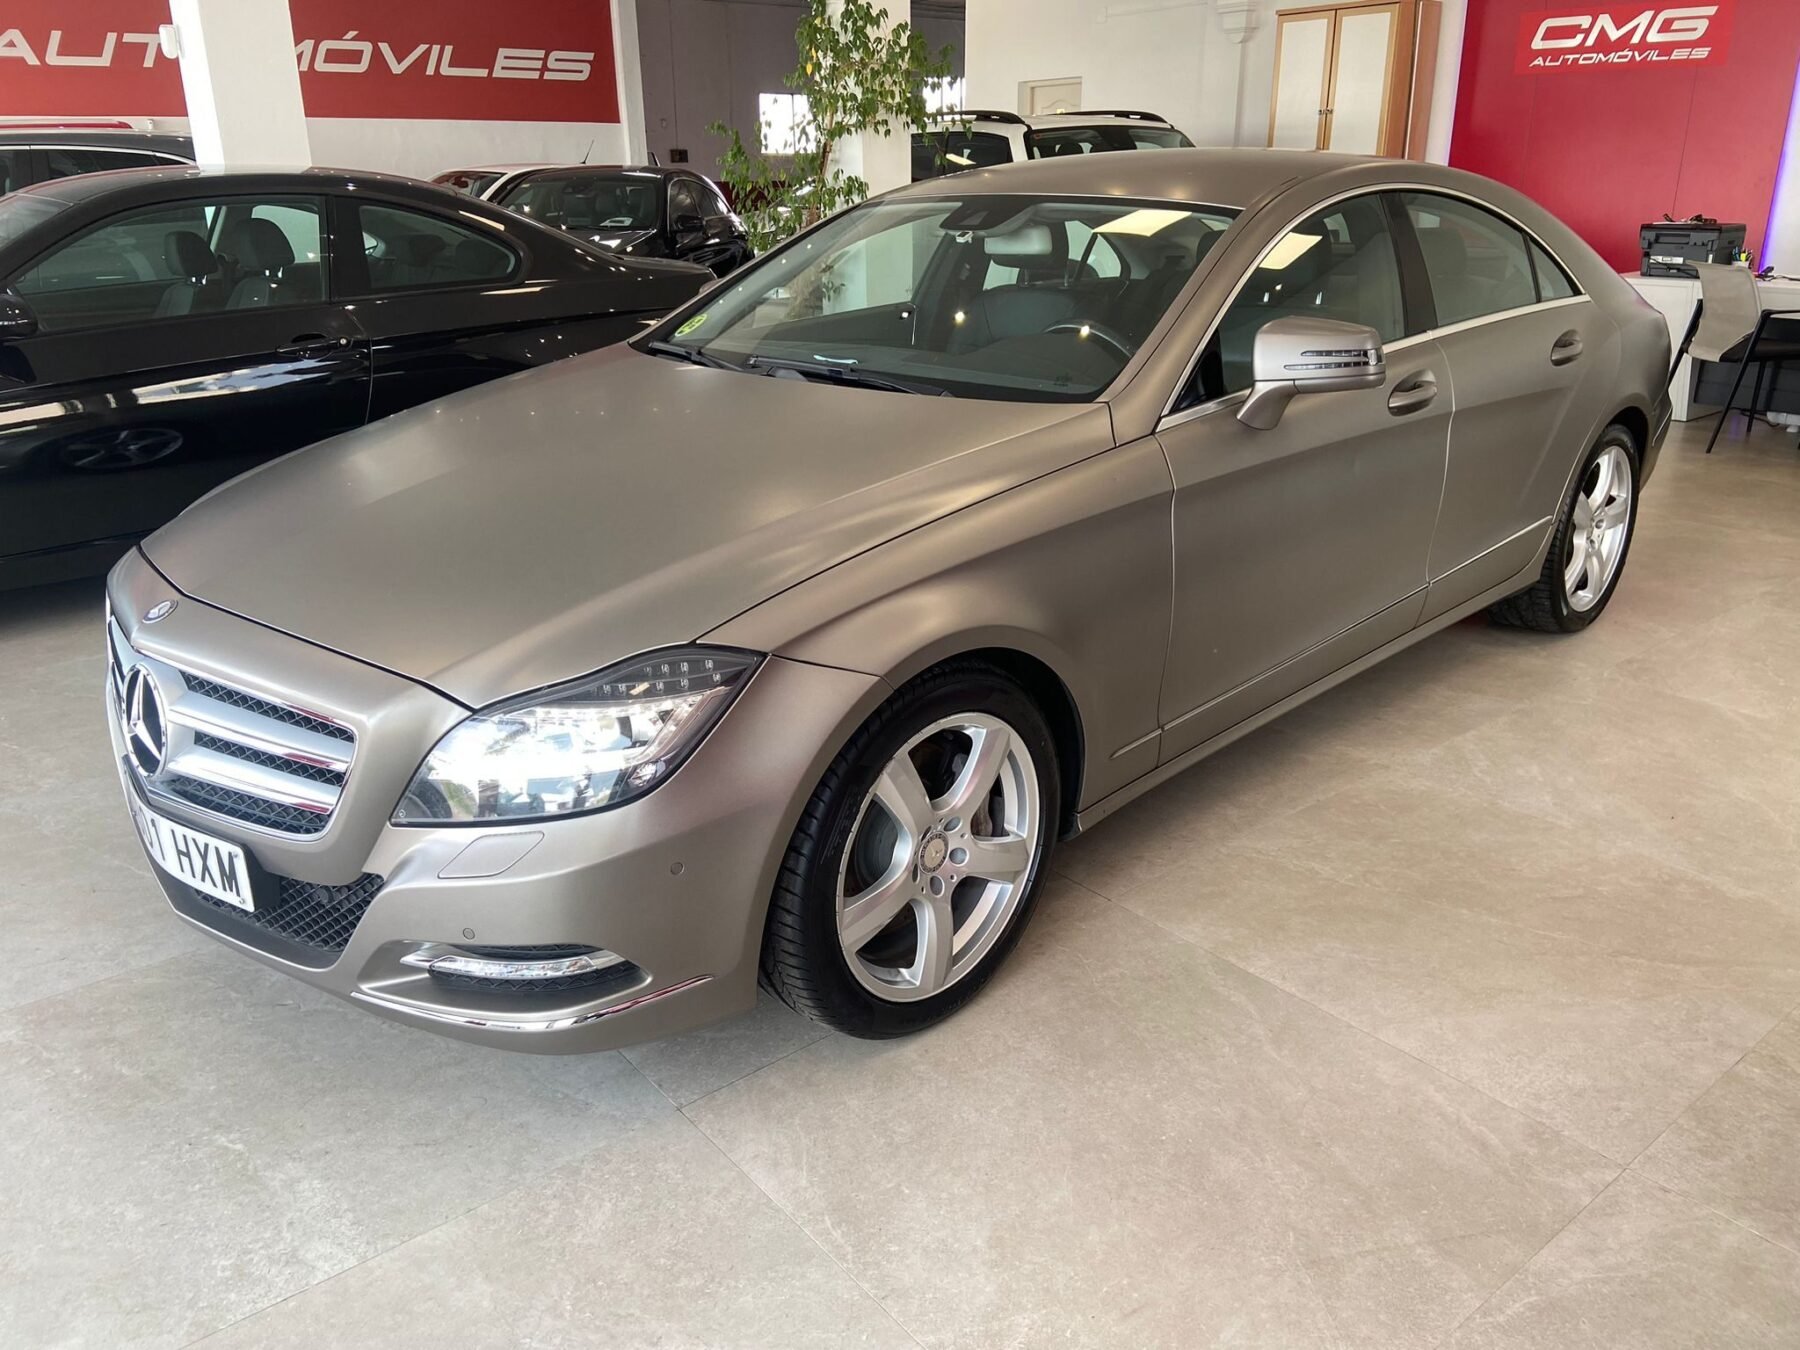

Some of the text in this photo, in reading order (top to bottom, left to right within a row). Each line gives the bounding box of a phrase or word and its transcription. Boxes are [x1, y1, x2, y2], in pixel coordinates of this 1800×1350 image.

[1531, 6, 1719, 49] CMG
[1529, 47, 1711, 67] AUTOMÓVILES
[171, 828, 241, 898] HXM
